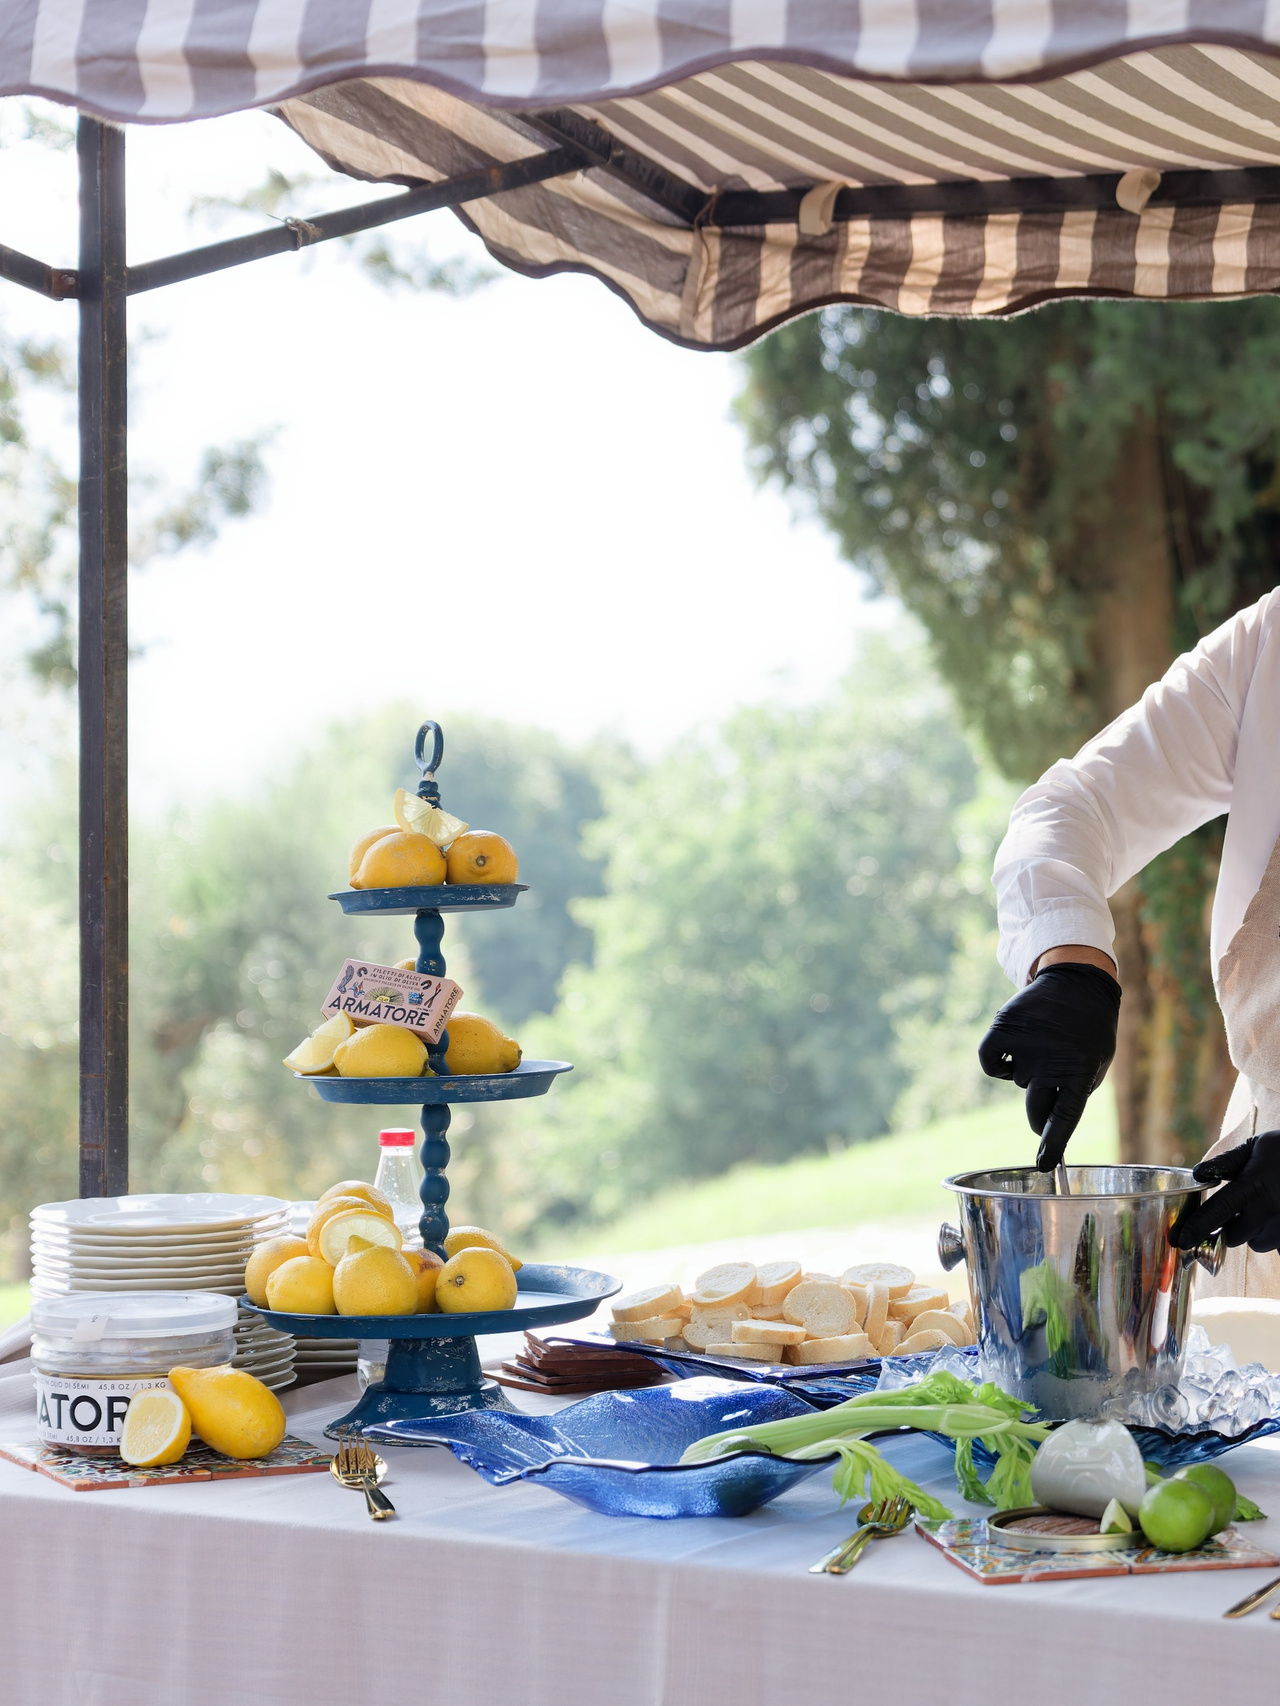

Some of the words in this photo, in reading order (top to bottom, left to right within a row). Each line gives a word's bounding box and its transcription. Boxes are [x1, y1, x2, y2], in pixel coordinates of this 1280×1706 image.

[372, 968, 397, 977] FILETTI
[405, 974, 422, 982] ALICI
[328, 995, 430, 1026] ARMATORE
[434, 986, 458, 1035] ARMATORE
[98, 1383, 116, 1391] 45,8
[155, 1381, 167, 1389] KG
